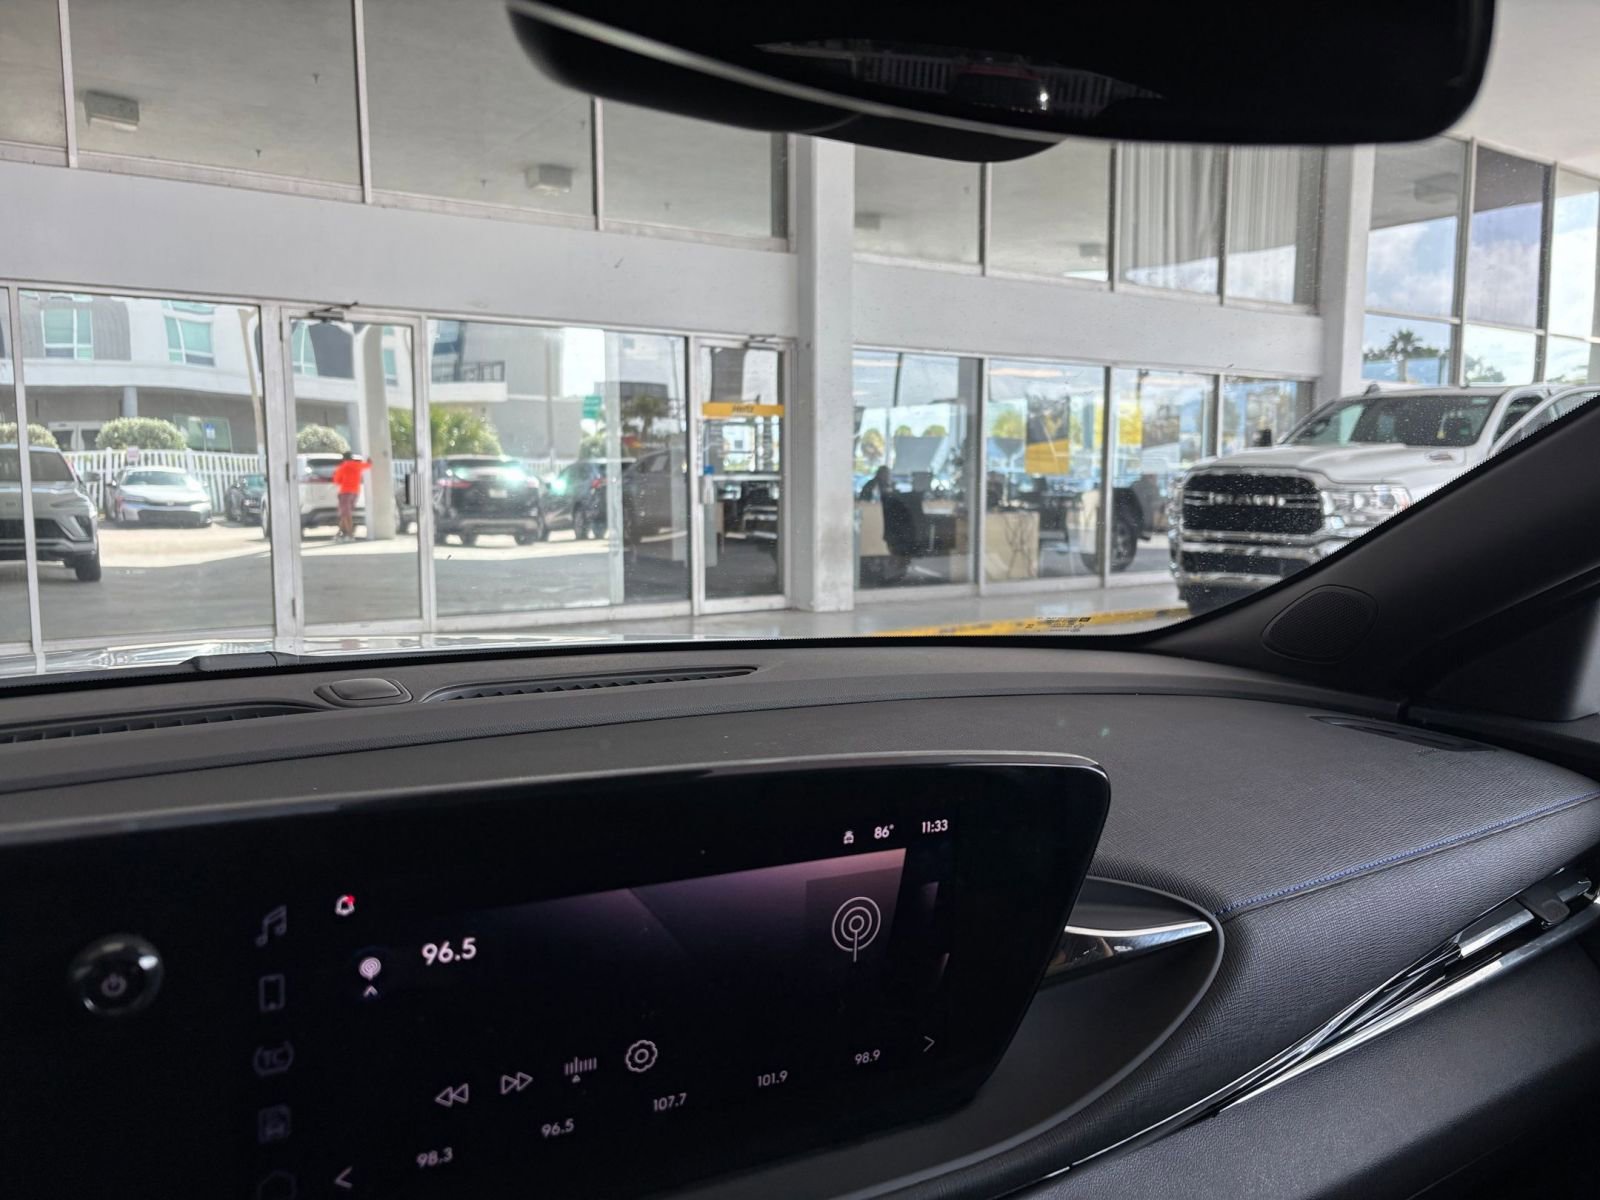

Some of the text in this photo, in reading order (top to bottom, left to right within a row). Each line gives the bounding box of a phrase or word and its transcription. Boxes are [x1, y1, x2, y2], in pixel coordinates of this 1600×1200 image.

[922, 819, 949, 834] 11:33
[421, 937, 477, 966] 96.5
[854, 1049, 881, 1065] 98.9
[757, 1070, 788, 1087] 101.9
[653, 1093, 687, 1111] 107.7
[541, 1118, 574, 1137] 96.5
[416, 1147, 453, 1168] 98.3
